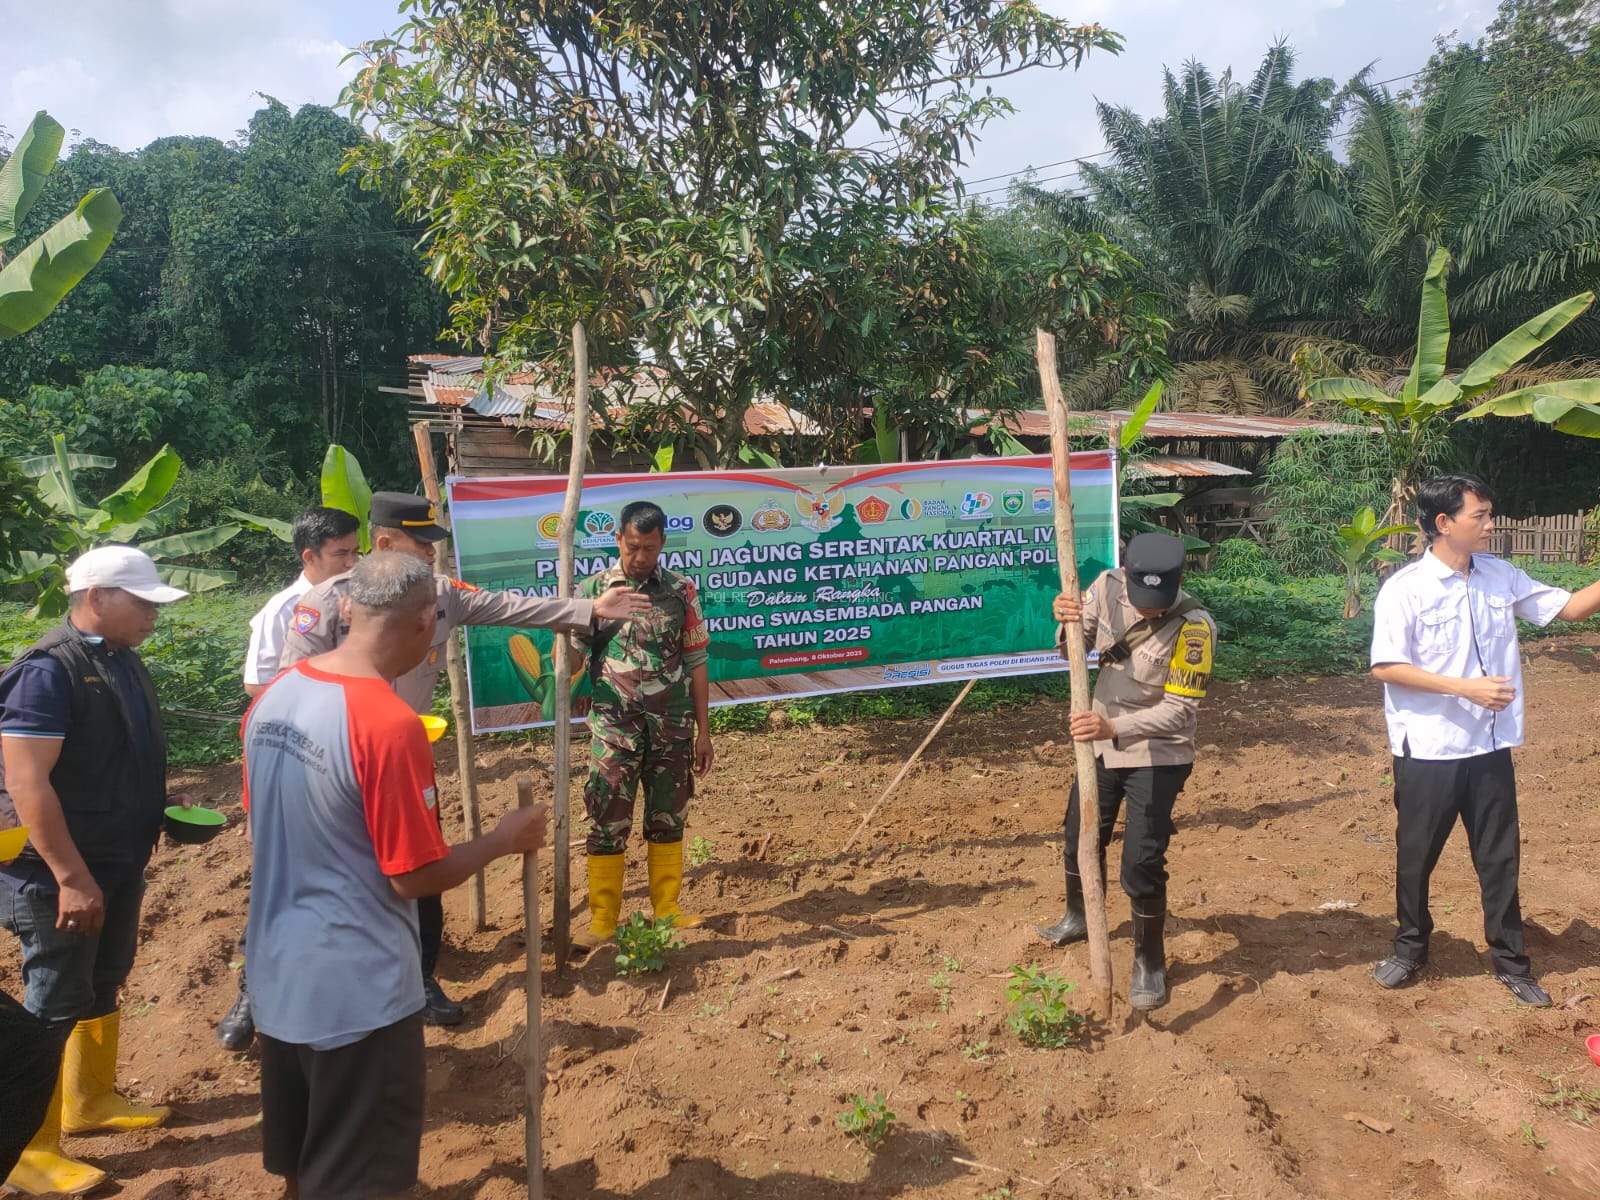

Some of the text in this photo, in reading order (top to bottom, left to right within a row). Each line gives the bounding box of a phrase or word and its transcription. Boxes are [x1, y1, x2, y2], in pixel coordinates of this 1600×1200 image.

[708, 543, 802, 566] JAGUNG
[809, 535, 925, 560] SERENTAK
[933, 528, 1028, 550] KUARTAL
[1034, 527, 1054, 543] IV
[708, 568, 797, 589] GUDANG
[804, 558, 928, 582] KETAHANAN
[935, 551, 1013, 571] PANGAN
[1021, 549, 1060, 565] POL
[747, 583, 881, 608] Dalam Rangka
[770, 603, 905, 627] SWASEMBADA
[910, 595, 983, 614] PANGAN
[754, 626, 871, 649] TAHUN 2025
[817, 652, 845, 660] Oktober
